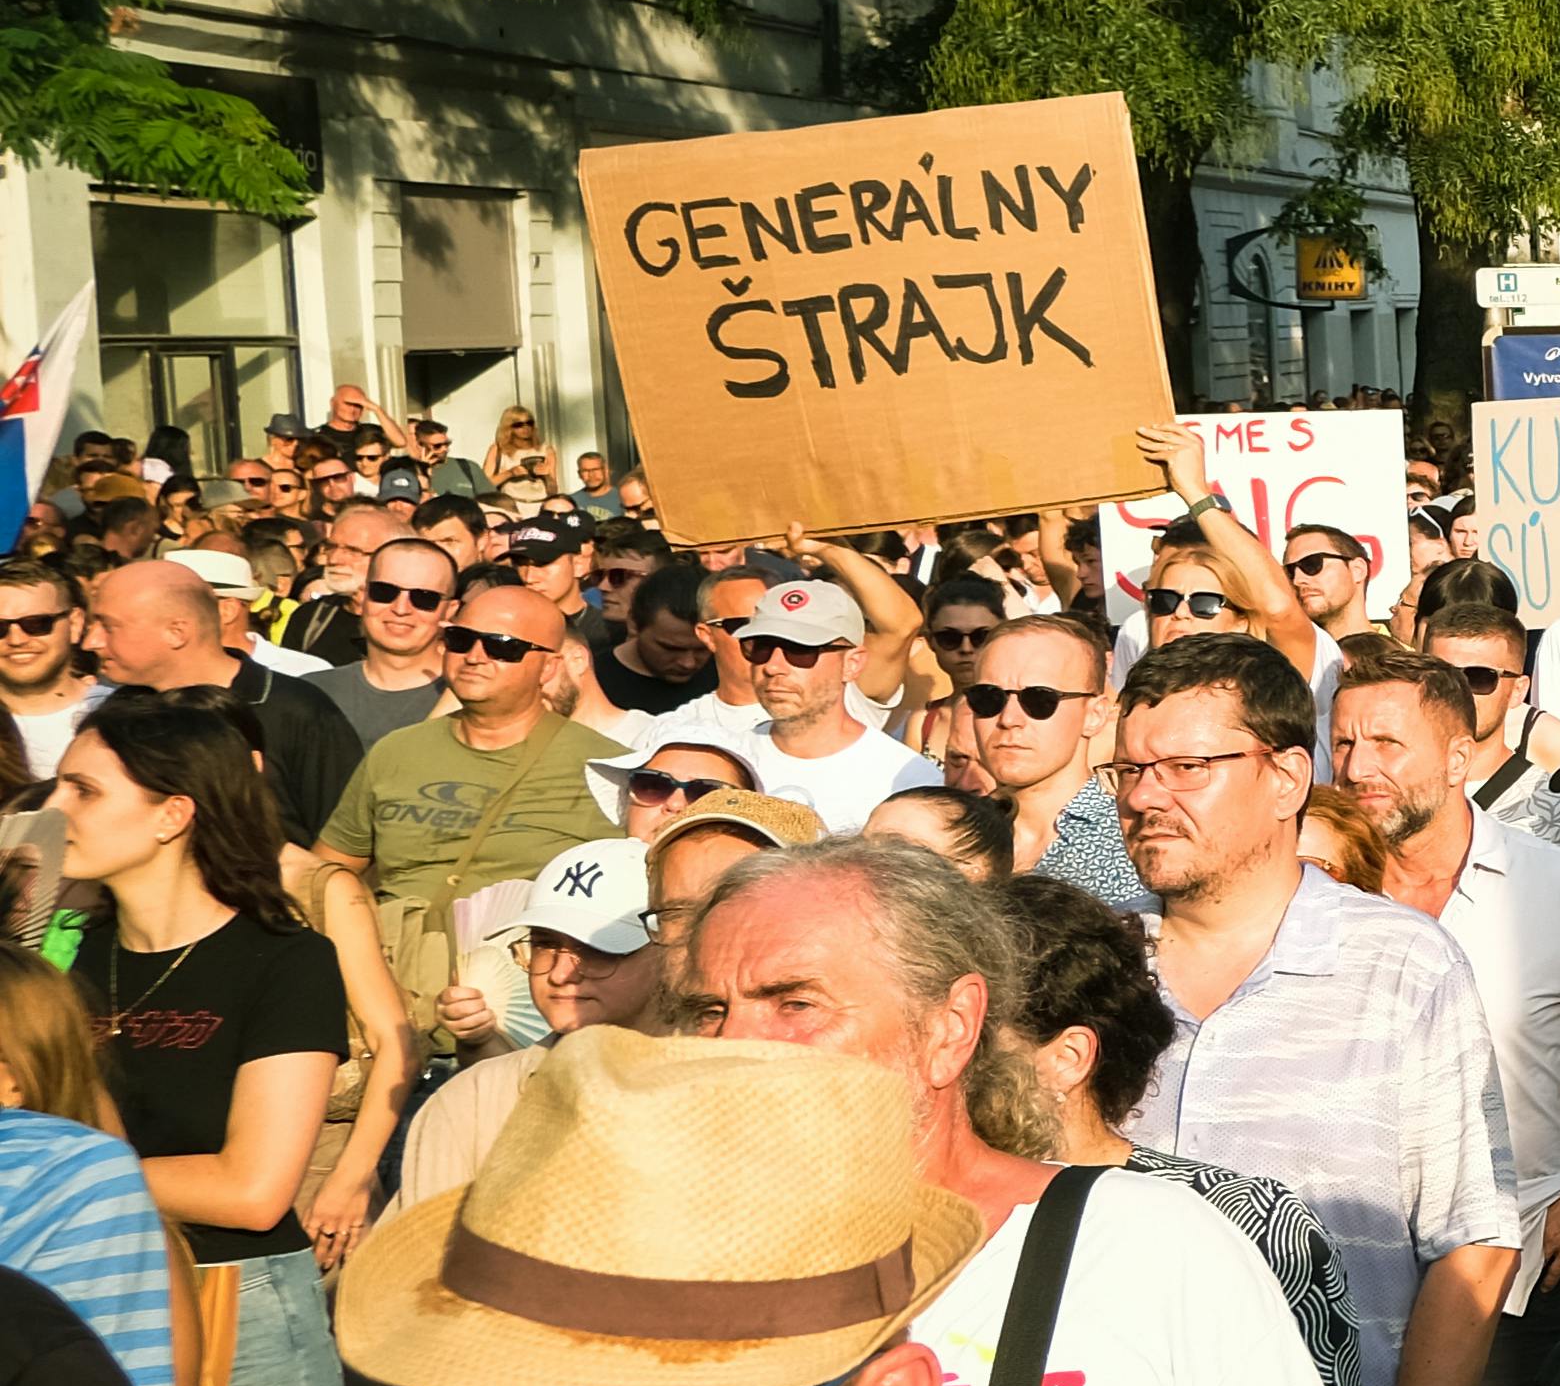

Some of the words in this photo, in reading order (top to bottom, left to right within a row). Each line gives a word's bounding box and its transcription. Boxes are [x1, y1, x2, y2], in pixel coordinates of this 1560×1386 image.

[623, 151, 1097, 278] GENERÁLNY
[706, 265, 1096, 399] ŠTRAJK
[1302, 280, 1356, 293] KNIHY
[1287, 418, 1316, 453] S
[1487, 510, 1551, 611] SÚ
